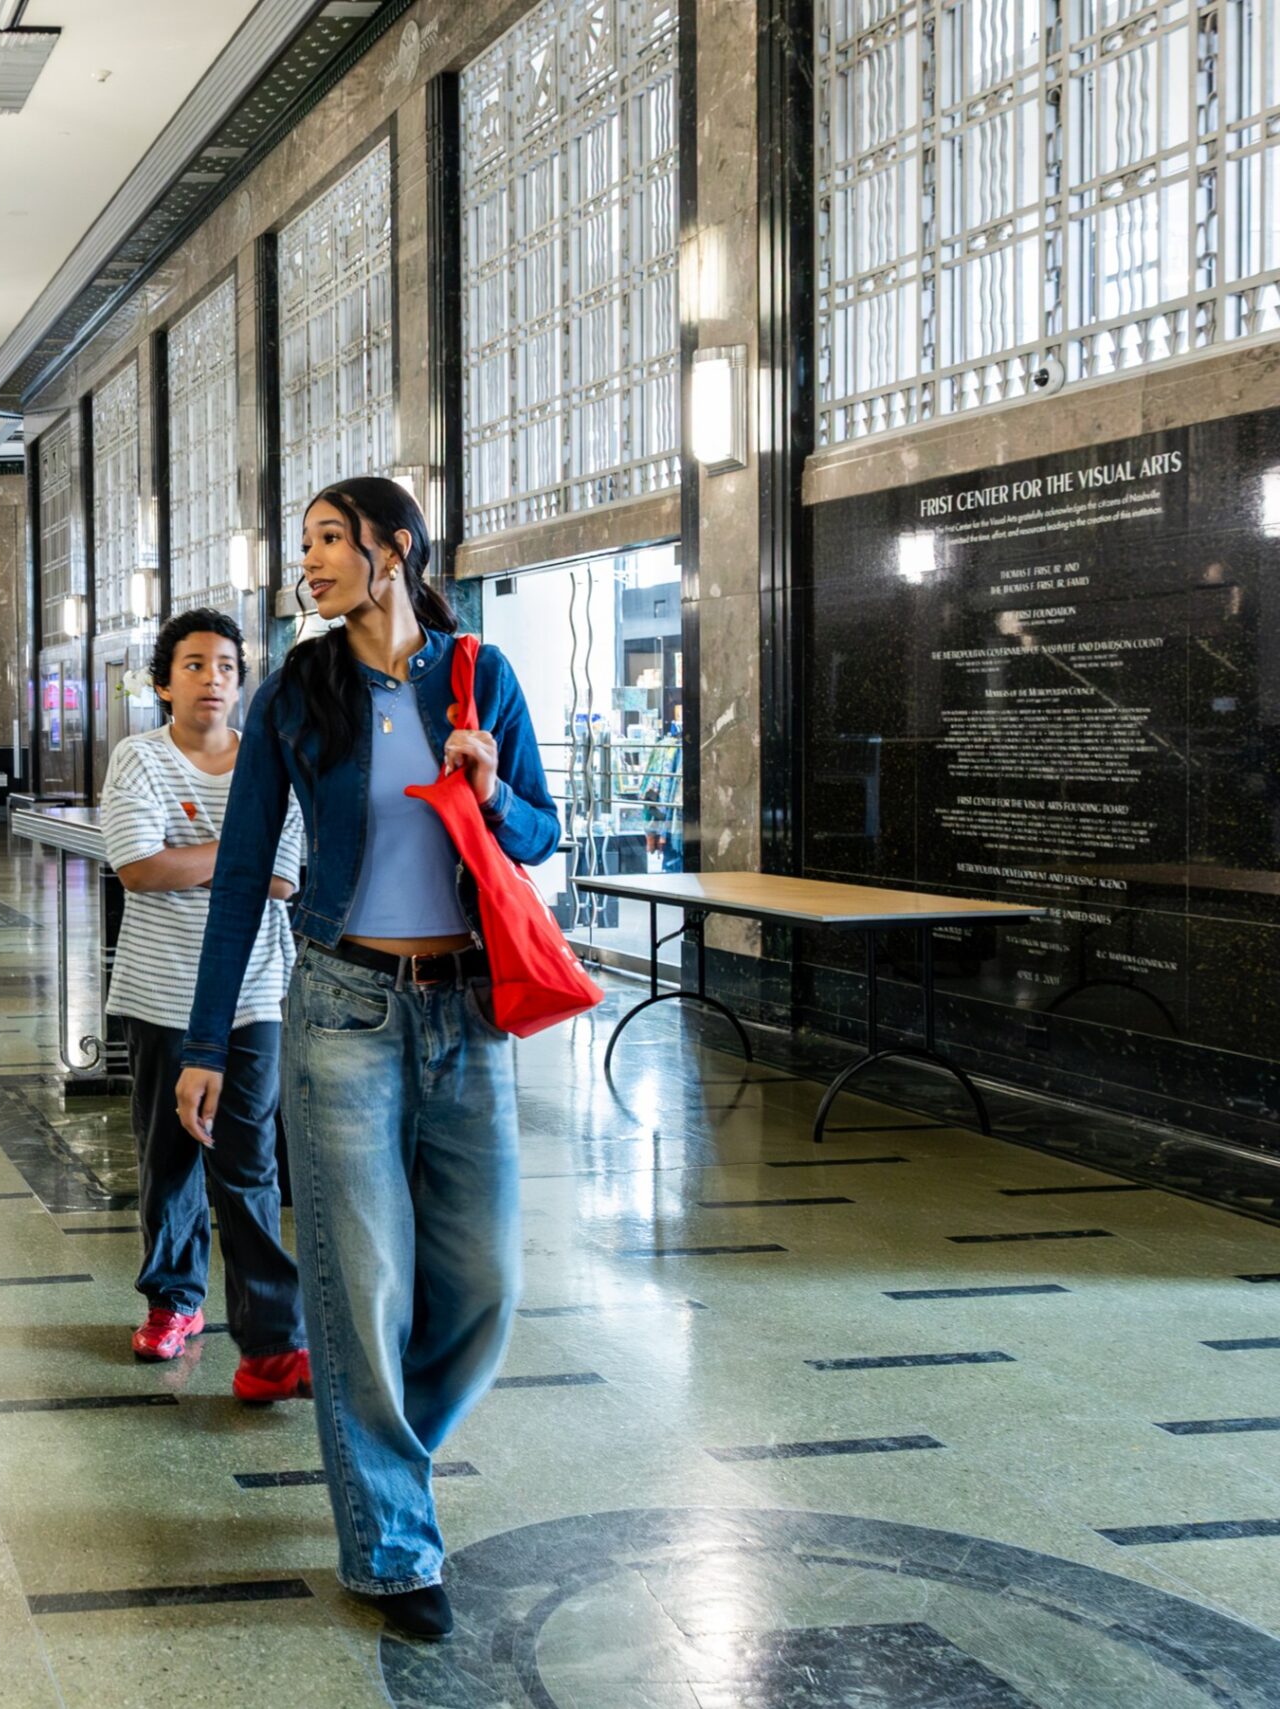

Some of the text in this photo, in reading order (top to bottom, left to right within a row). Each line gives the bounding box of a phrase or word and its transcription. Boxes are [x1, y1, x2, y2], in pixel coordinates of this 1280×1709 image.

[920, 451, 1183, 518] FRIST CENTER FOR THE VISUAL ARTS
[955, 521, 973, 531] Center
[990, 515, 1006, 526] Visual
[1077, 641, 1093, 651] AND
